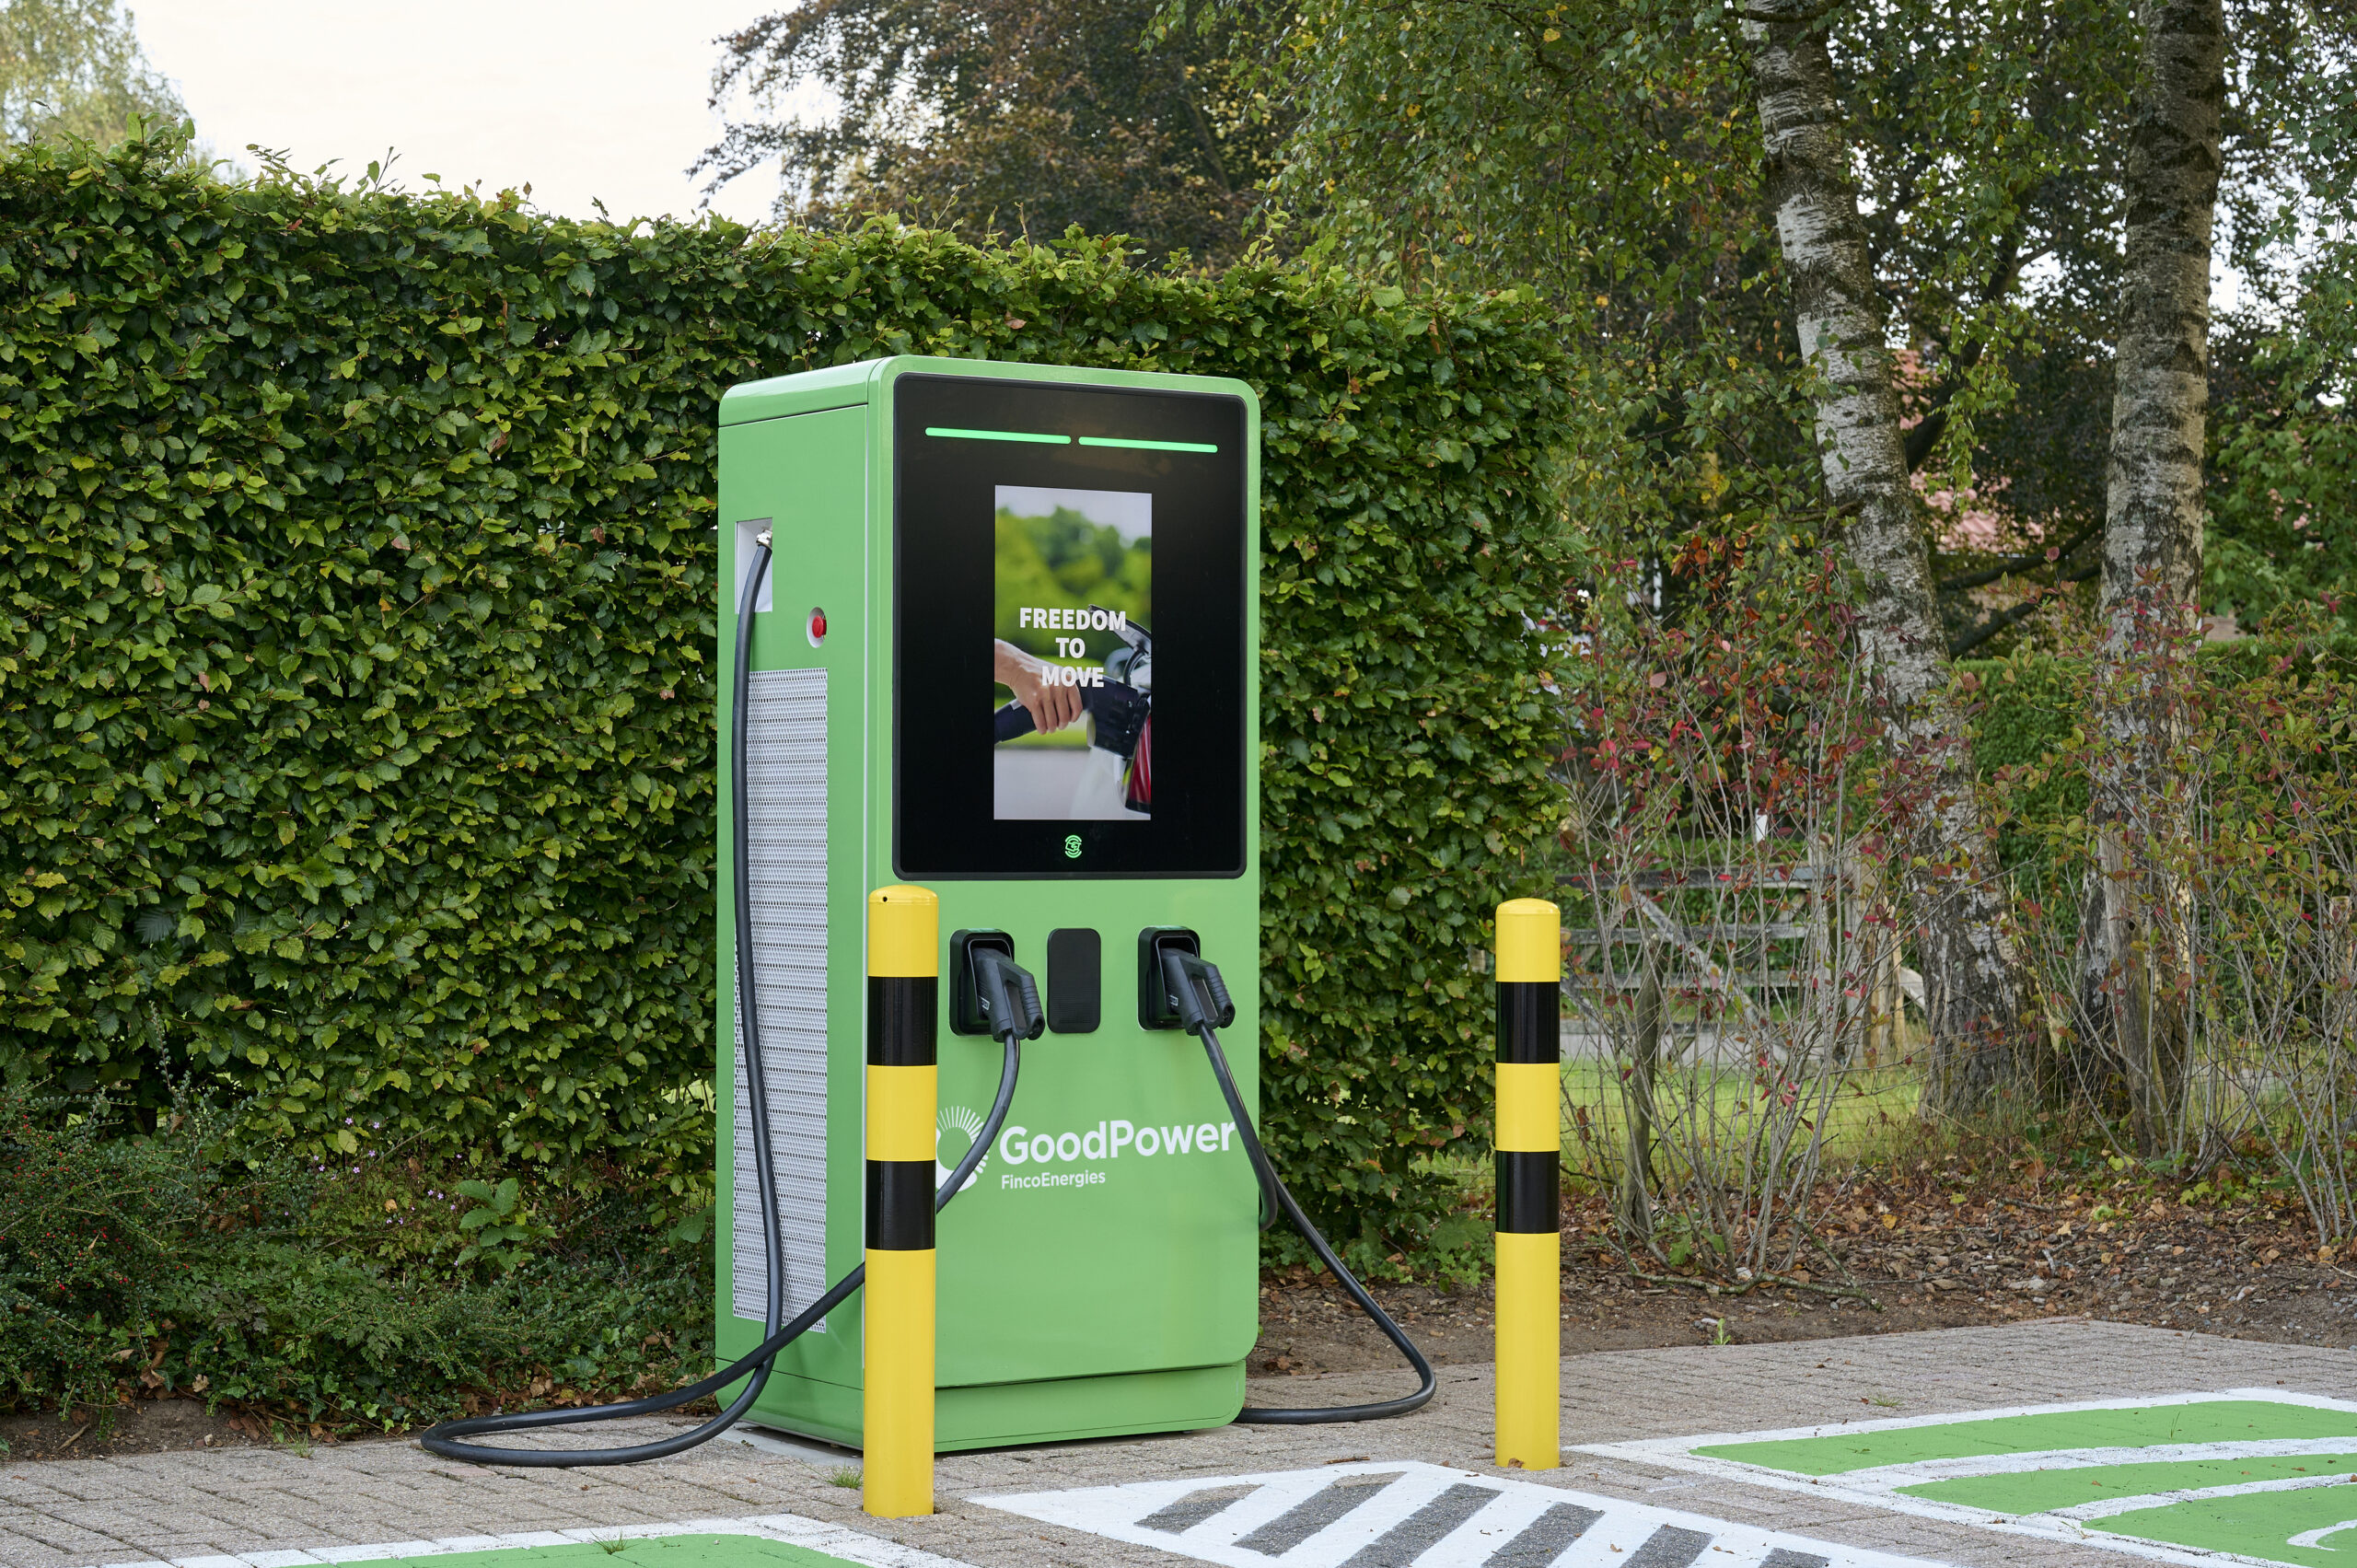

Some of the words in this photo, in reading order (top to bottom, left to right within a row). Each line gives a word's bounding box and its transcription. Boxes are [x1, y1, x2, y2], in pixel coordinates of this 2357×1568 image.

[1019, 608, 1126, 632] FREEDOM
[1055, 637, 1086, 659] TO
[1041, 666, 1104, 688] MOVE
[999, 1120, 1236, 1165] GoodPower
[1001, 1169, 1106, 1190] FincoEnergies
